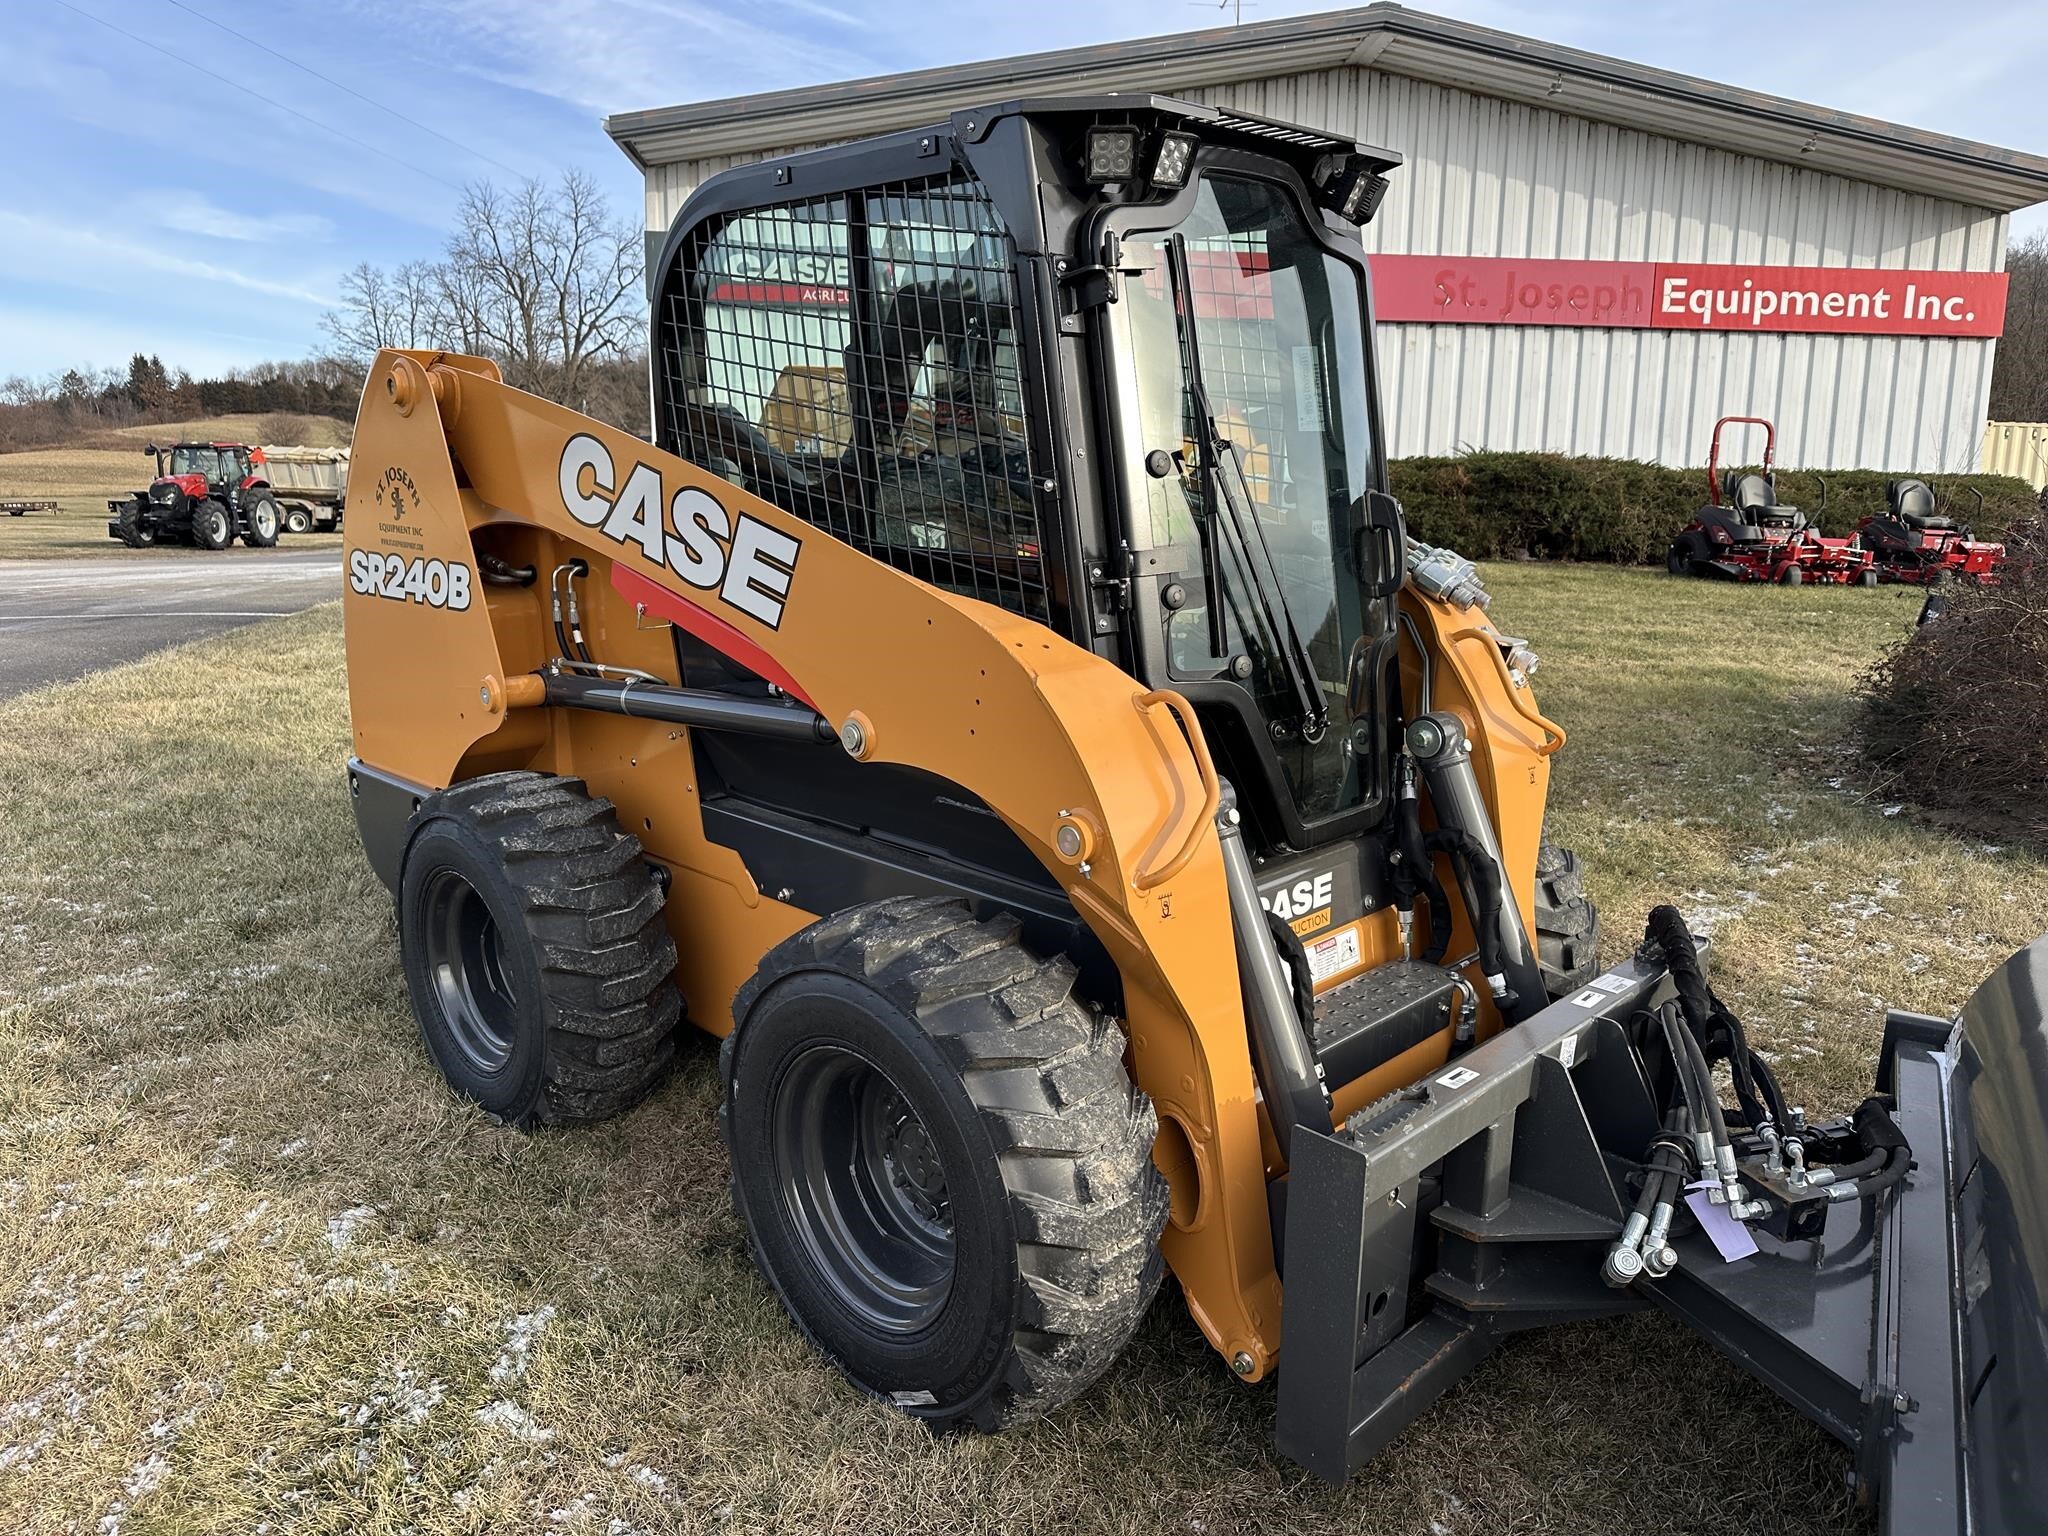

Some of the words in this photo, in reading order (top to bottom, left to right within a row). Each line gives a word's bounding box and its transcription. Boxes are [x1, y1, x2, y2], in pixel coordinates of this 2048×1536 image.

[724, 253, 849, 285] CASE
[1433, 269, 1488, 308] St.
[1500, 271, 1643, 320] Joseph
[1661, 278, 1890, 325] Equipment
[1904, 284, 1975, 322] Inc.
[385, 467, 421, 509] JOSEPH
[379, 523, 411, 535] EQUIPMENT
[558, 433, 802, 631] CASE
[350, 548, 471, 612] SR240B
